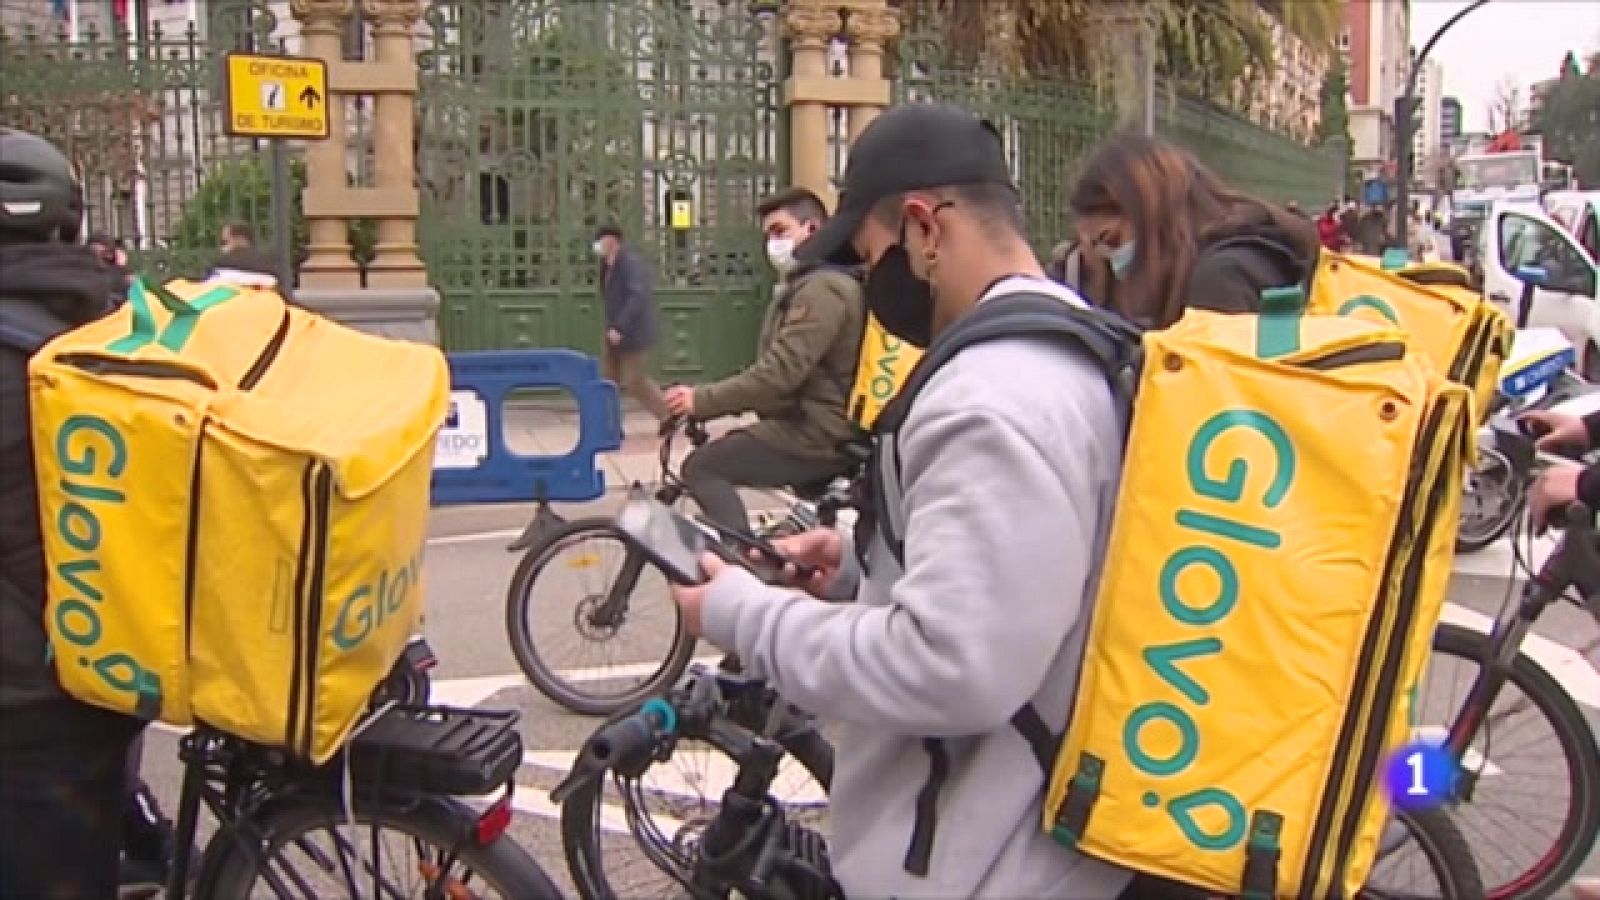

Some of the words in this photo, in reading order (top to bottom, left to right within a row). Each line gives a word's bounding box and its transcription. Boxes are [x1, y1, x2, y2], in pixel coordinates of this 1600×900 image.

[249, 62, 308, 78] OFICINA
[237, 114, 254, 128] DE
[261, 115, 322, 130] TURISMO
[871, 331, 901, 399] ovo
[55, 414, 128, 649] Glovo
[333, 546, 424, 651] Glov
[1122, 408, 1297, 776] Glovo
